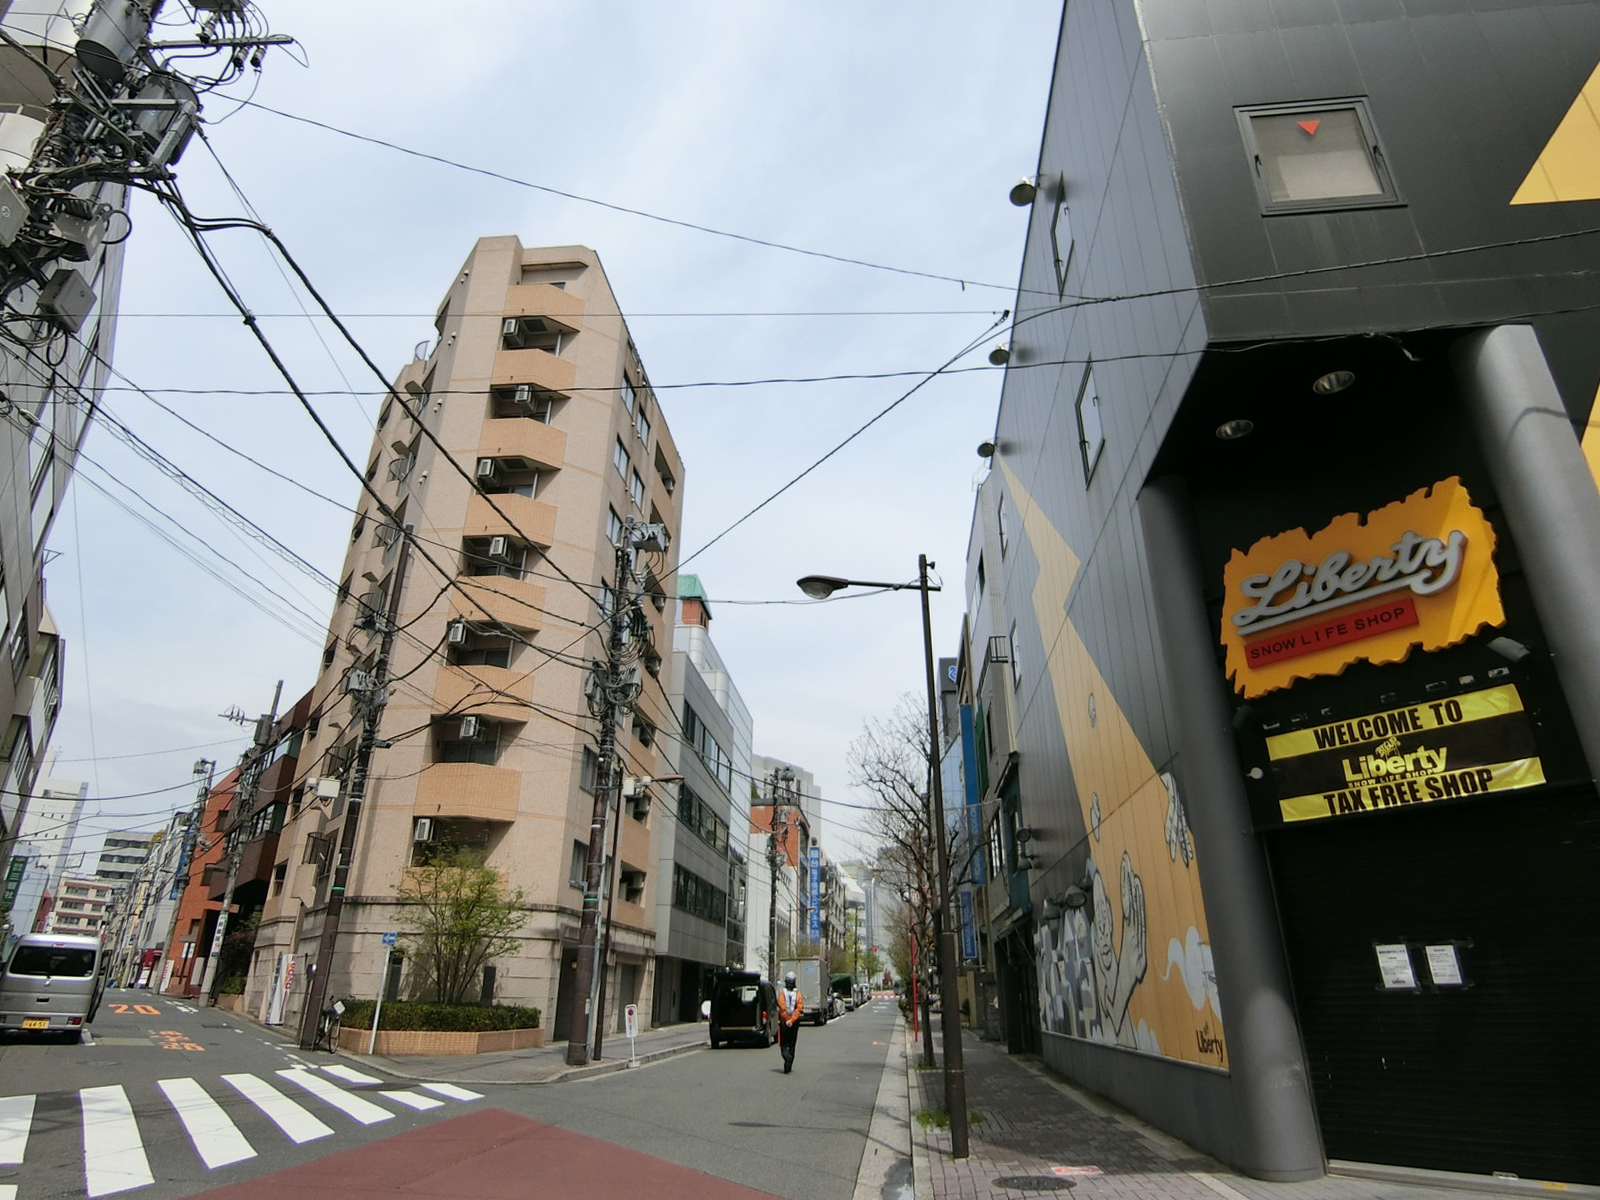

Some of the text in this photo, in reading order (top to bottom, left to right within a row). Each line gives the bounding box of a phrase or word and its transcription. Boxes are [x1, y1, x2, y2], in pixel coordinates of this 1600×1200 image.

[1231, 530, 1468, 627] Liberty
[1250, 607, 1405, 659] SNOW LIFE SHOP
[1313, 699, 1463, 750] WELCOME TO
[1342, 745, 1447, 782] Liberty
[1348, 769, 1435, 788] SNOW LIFE SHOP
[1324, 768, 1493, 815] TAX FREE SHOP
[108, 1003, 162, 1015] 20
[1196, 1029, 1224, 1063] Liberty
